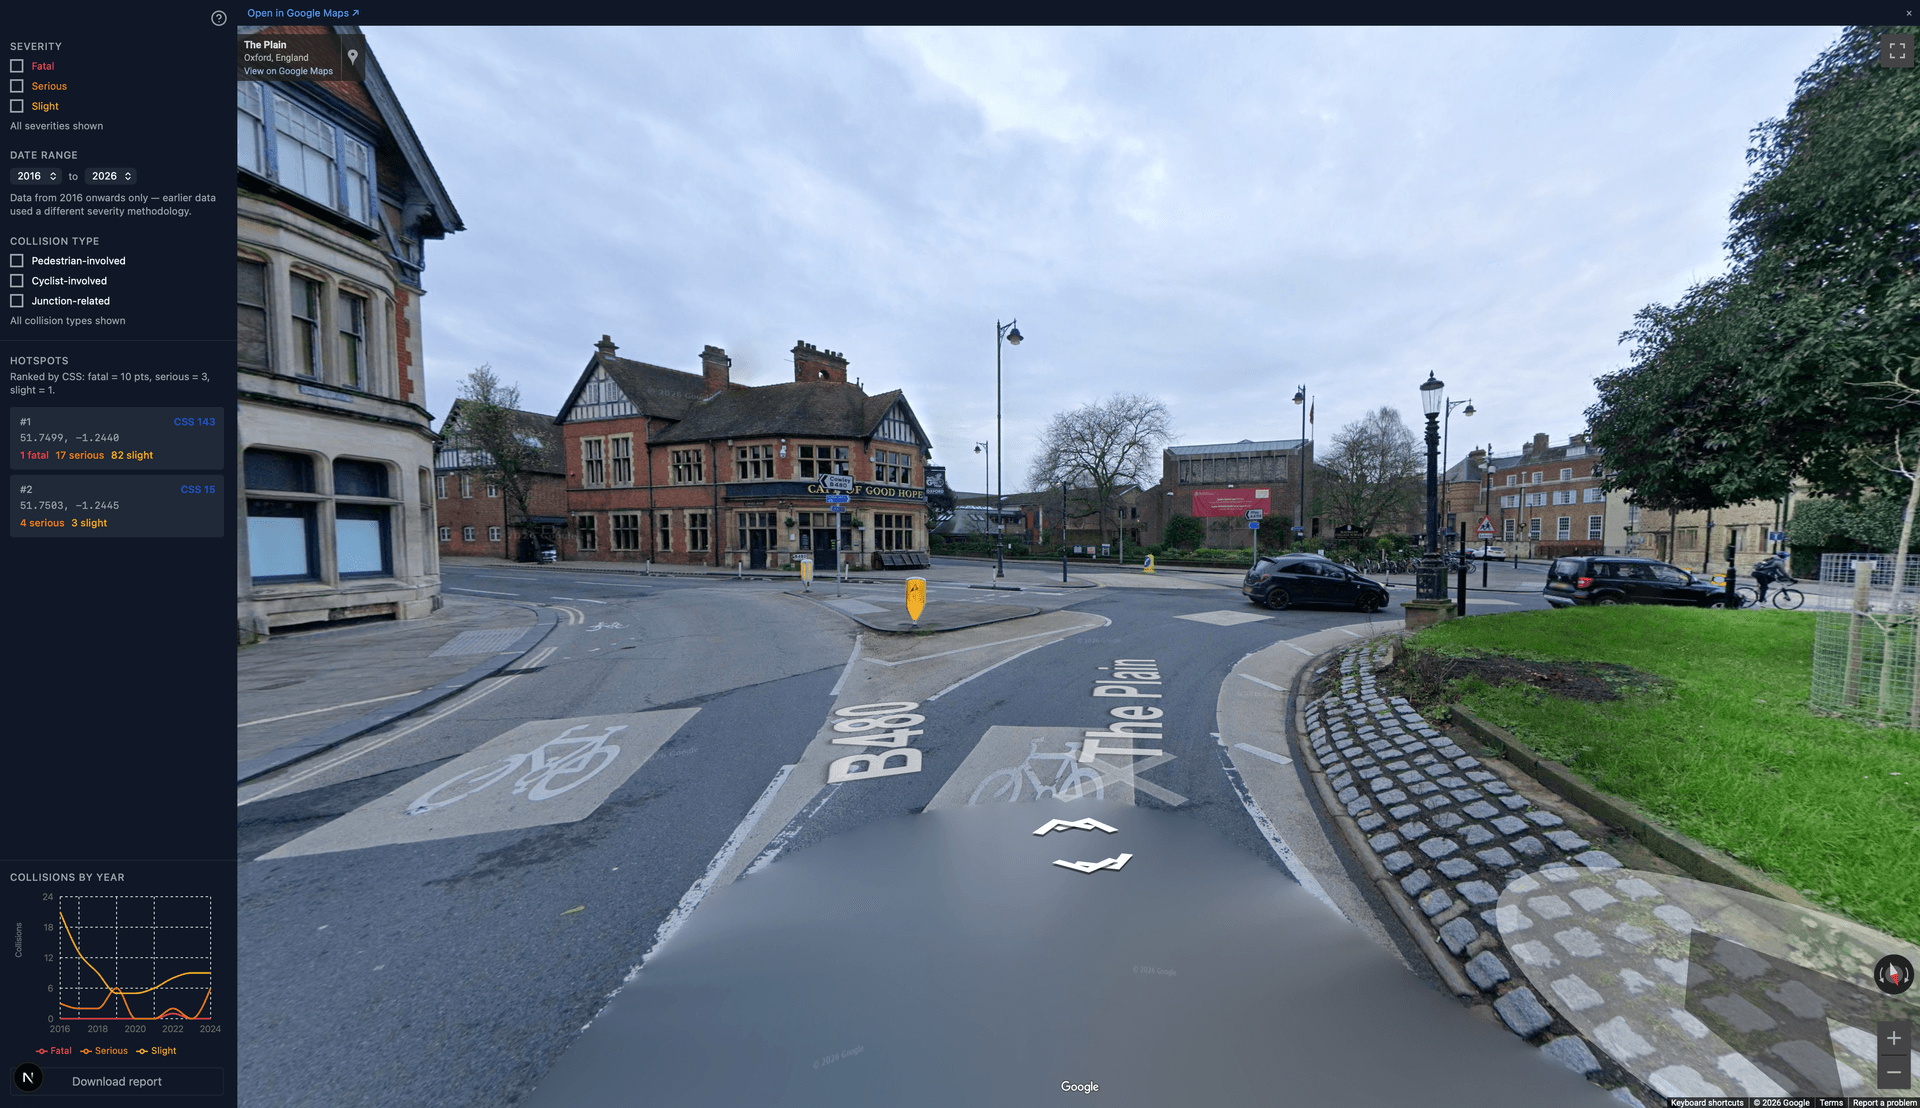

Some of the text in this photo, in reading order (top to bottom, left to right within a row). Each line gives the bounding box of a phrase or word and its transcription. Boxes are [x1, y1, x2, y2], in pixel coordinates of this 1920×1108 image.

[247, 8, 350, 20] Open in Google Maps
[9, 41, 62, 51] SEVERITY
[31, 61, 55, 71] Fatal
[31, 81, 68, 91] Serious
[31, 101, 60, 113] Slight
[9, 121, 104, 131] All severities shown
[10, 150, 78, 160] DATE RANGE
[17, 171, 42, 181] 2016
[68, 172, 79, 181] to
[92, 171, 118, 181] 2026
[10, 193, 33, 203] Data
[34, 192, 57, 203] from
[59, 193, 84, 203] 2016
[85, 193, 126, 203] onwards
[127, 193, 149, 204] only
[162, 192, 193, 203] earlier
[194, 193, 217, 203] data
[9, 206, 192, 218] used a different severity methodology.
[9, 236, 100, 246] COLLISION TYPE
[31, 255, 126, 266] Pedestrian-involved
[31, 275, 108, 288] Cyclist-involved
[31, 295, 111, 306] Junction-related
[9, 315, 126, 327] All collision types shown
[10, 356, 69, 366] HOTSPOTS
[10, 371, 46, 382] Ranked
[47, 371, 60, 383] by
[61, 371, 85, 382] CSS:
[87, 371, 109, 382] fatal
[120, 371, 132, 382] 10
[134, 372, 152, 383] pts,
[154, 371, 190, 382] serious
[201, 371, 210, 383] 3,
[9, 385, 37, 397] slight
[47, 385, 56, 395] 1.
[19, 417, 31, 426] #1
[173, 417, 216, 427] CSS 143
[20, 433, 68, 444] 51.7499,
[19, 450, 154, 462] 1 fatal 17 serious 82 slight
[19, 484, 33, 494] #2
[180, 484, 216, 494] CSS 15
[807, 484, 841, 494] CA
[865, 486, 896, 497] GOOD
[898, 489, 924, 499] HOPE
[20, 500, 68, 512] 51.7503,
[19, 517, 108, 530] 4 serious 3 slight
[9, 872, 125, 882] COLLISIONS BY YEAR
[42, 892, 54, 901] 24
[43, 923, 54, 932] 18
[14, 922, 23, 958] Collisions
[43, 953, 54, 962] 12
[47, 984, 54, 993] 6
[47, 1014, 54, 1023] 0
[49, 1024, 222, 1034] 2016 2018 2020 2022 2024
[50, 1046, 72, 1055] Fatal
[94, 1046, 129, 1055] Serious
[150, 1046, 177, 1057] Slight
[72, 1076, 163, 1089] Download report
